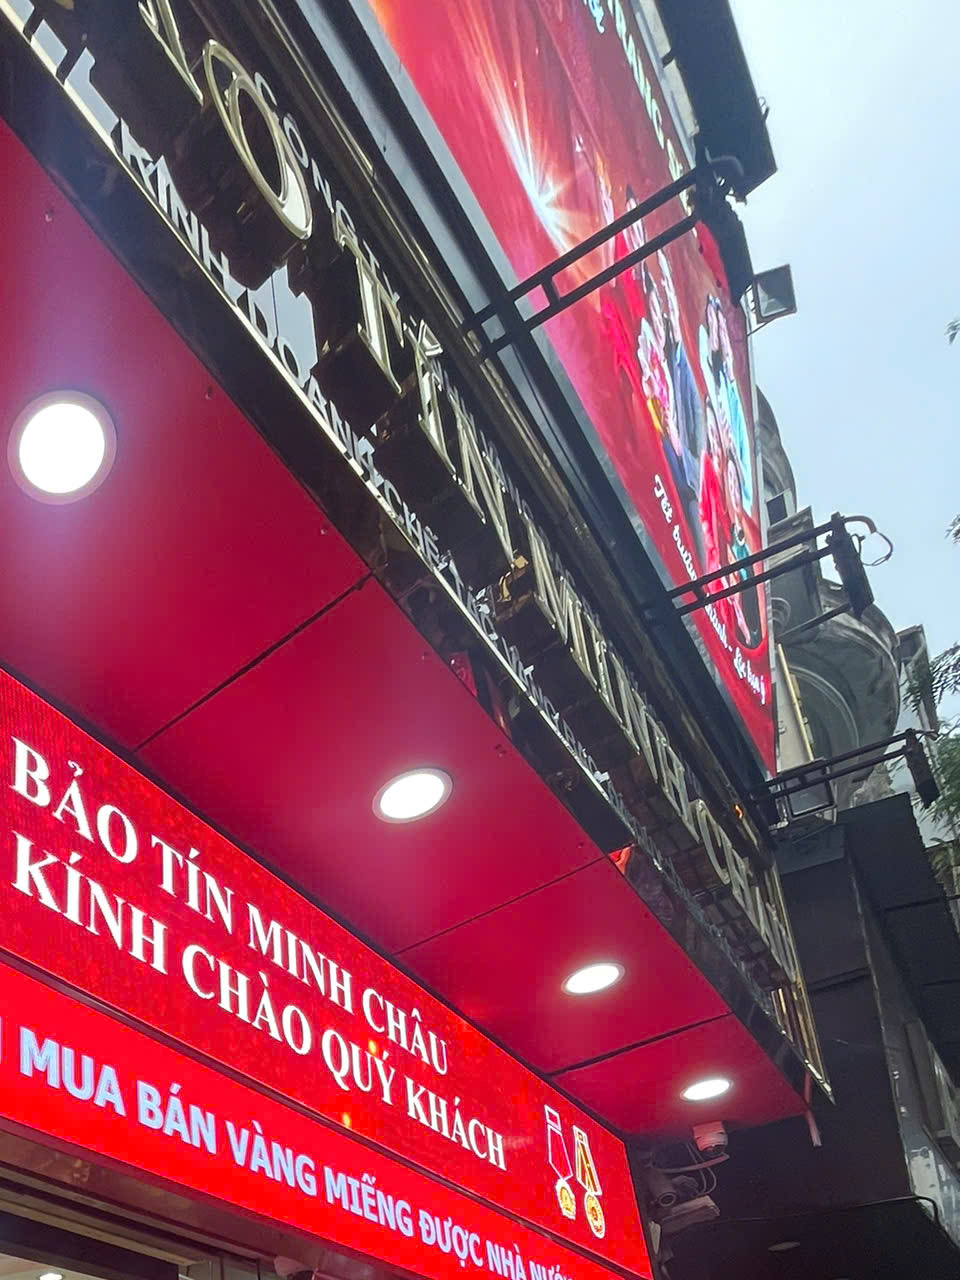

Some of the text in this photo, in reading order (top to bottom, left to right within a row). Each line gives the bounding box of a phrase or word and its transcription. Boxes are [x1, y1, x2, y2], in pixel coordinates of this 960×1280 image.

[9, 737, 449, 1076] BẢO TÍN MINH CHÂU
[11, 832, 168, 975] KÍNH
[182, 944, 312, 1056] CHÀO
[322, 1029, 396, 1106] QUÝ
[405, 1076, 508, 1173] KHÁCH
[19, 1026, 127, 1117] MUA
[137, 1079, 218, 1155] BÁN
[226, 1119, 317, 1197] VÀNG
[324, 1166, 415, 1239] MIẾNG
[419, 1209, 484, 1269] ĐƯỢC
